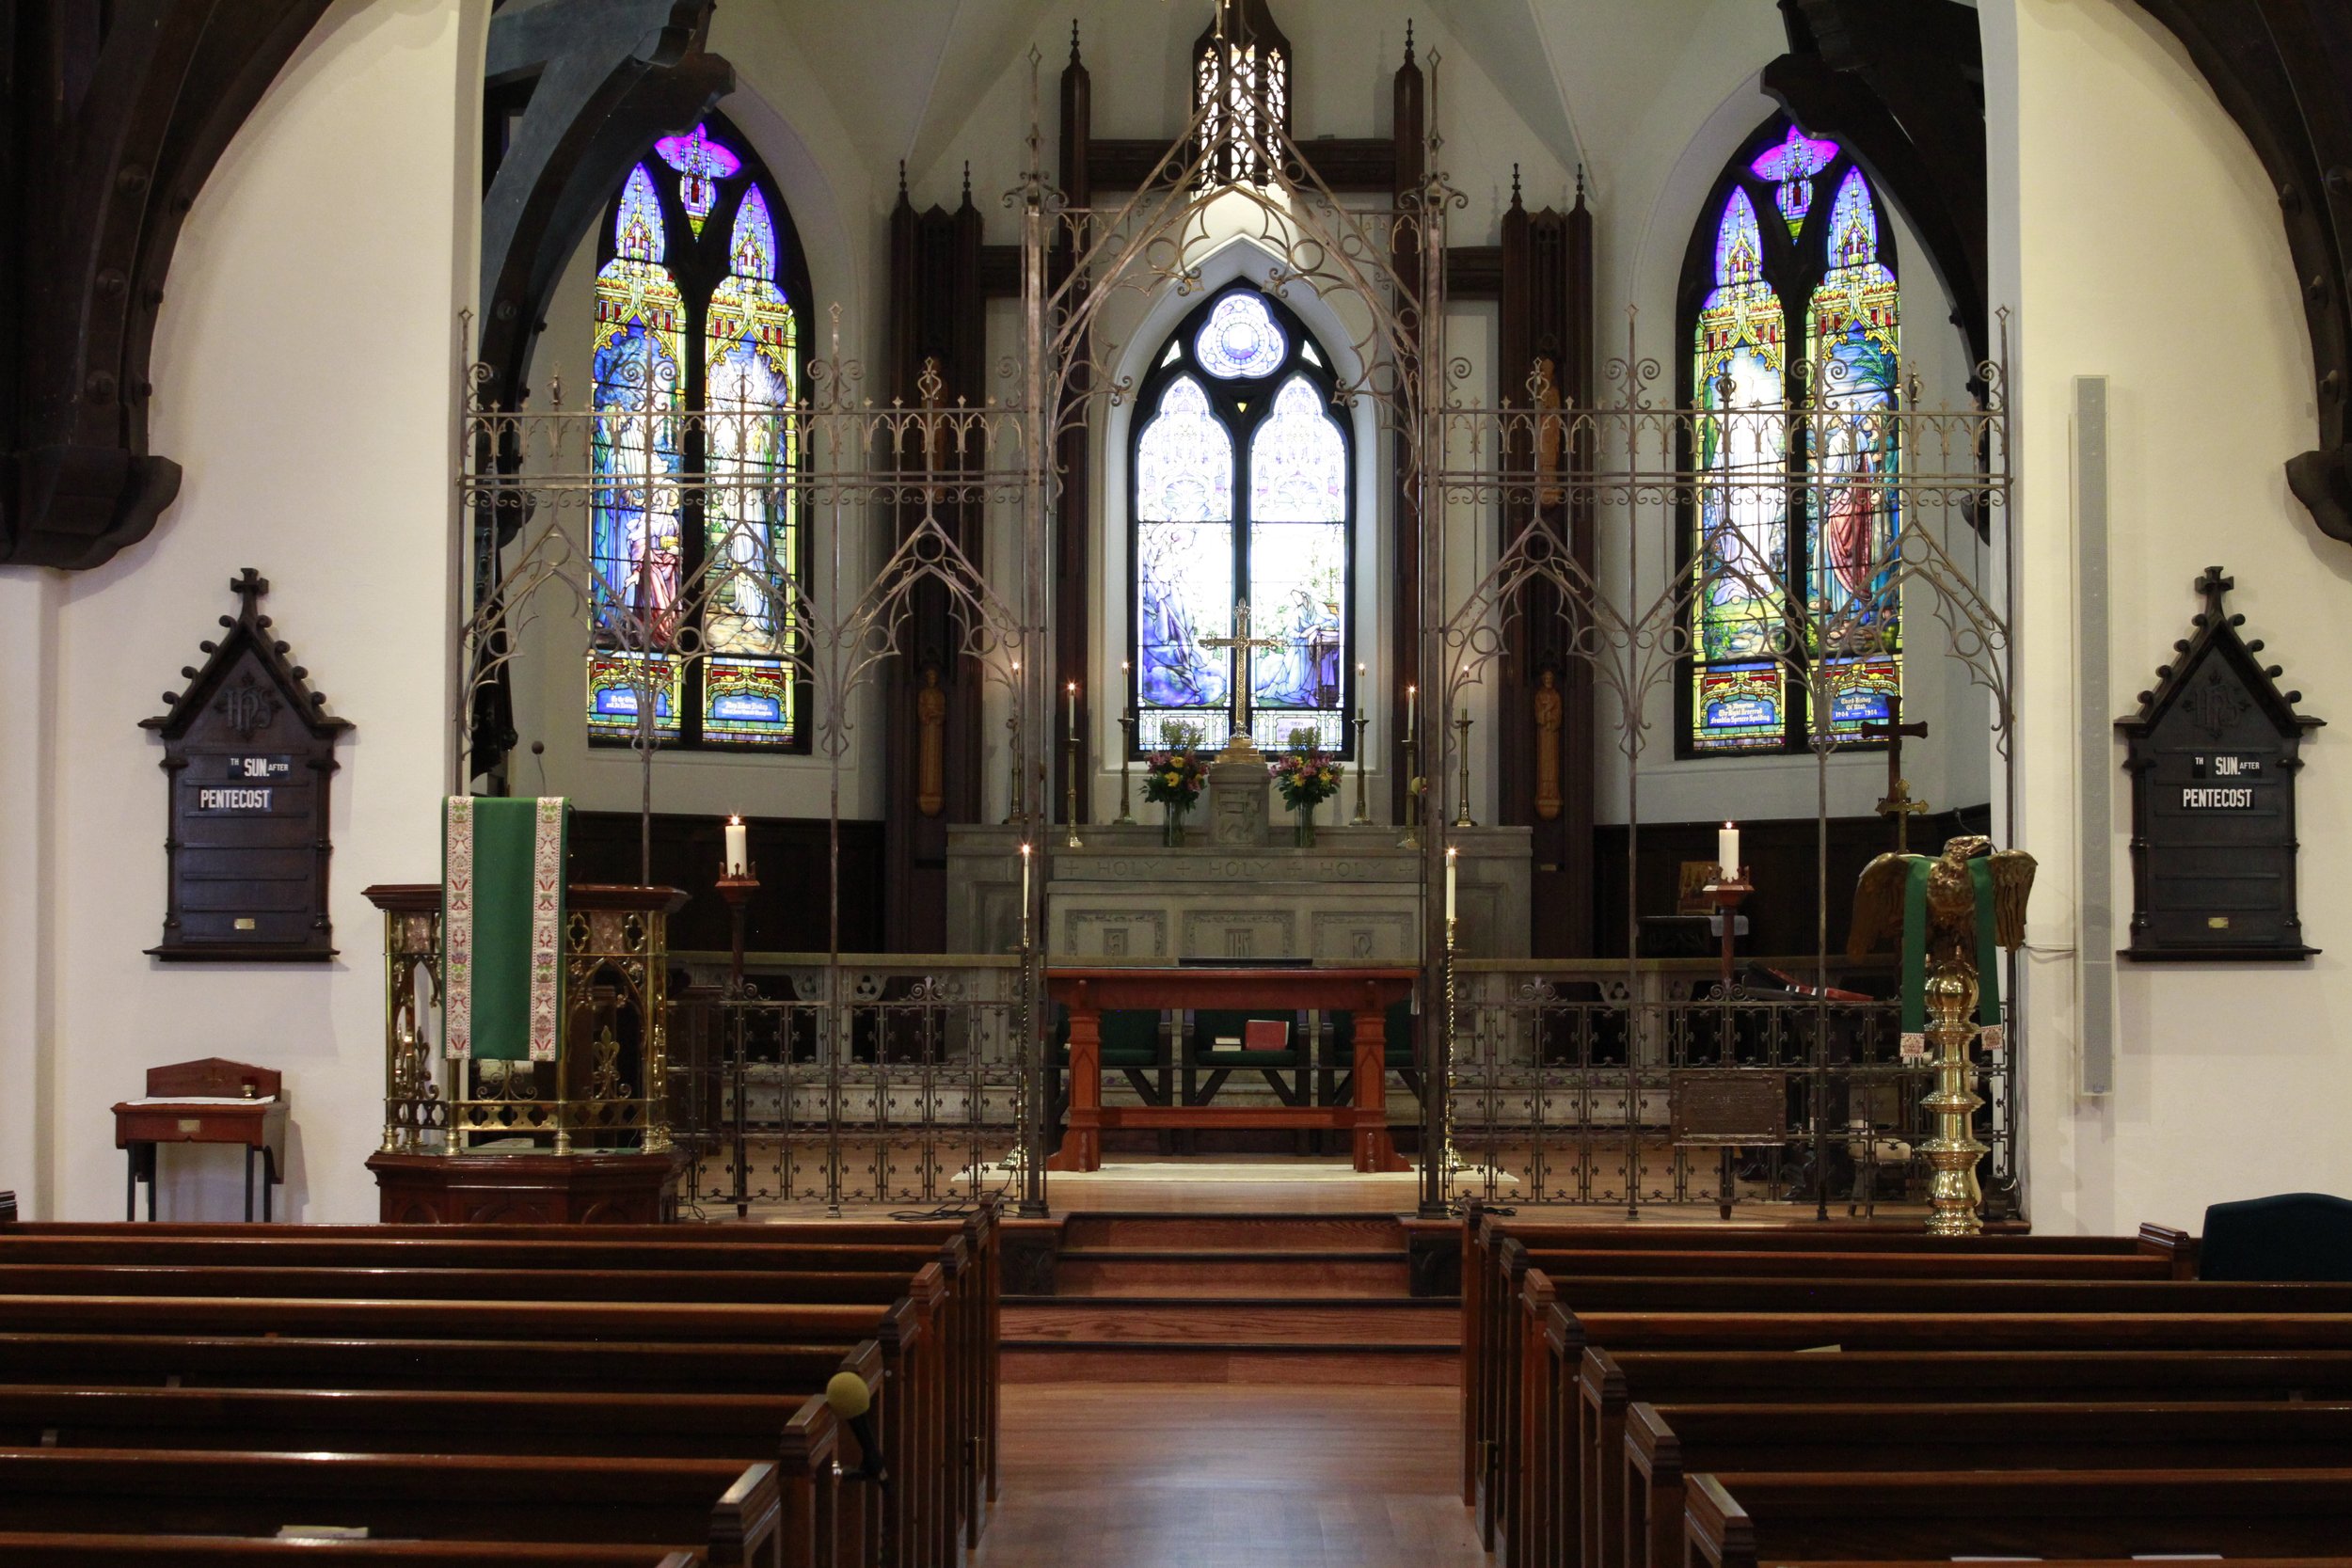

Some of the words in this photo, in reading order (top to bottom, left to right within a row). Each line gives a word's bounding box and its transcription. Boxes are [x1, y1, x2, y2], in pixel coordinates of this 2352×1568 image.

[244, 758, 270, 777] SUN.
[268, 763, 289, 771] AFTER
[2216, 756, 2241, 775] SUN.
[200, 789, 270, 808] PENTECOST
[2183, 788, 2252, 807] PENTECOST
[1097, 861, 1160, 877] HOLY
[1209, 861, 1271, 877] HOLY
[1320, 862, 1382, 877] HOLY
